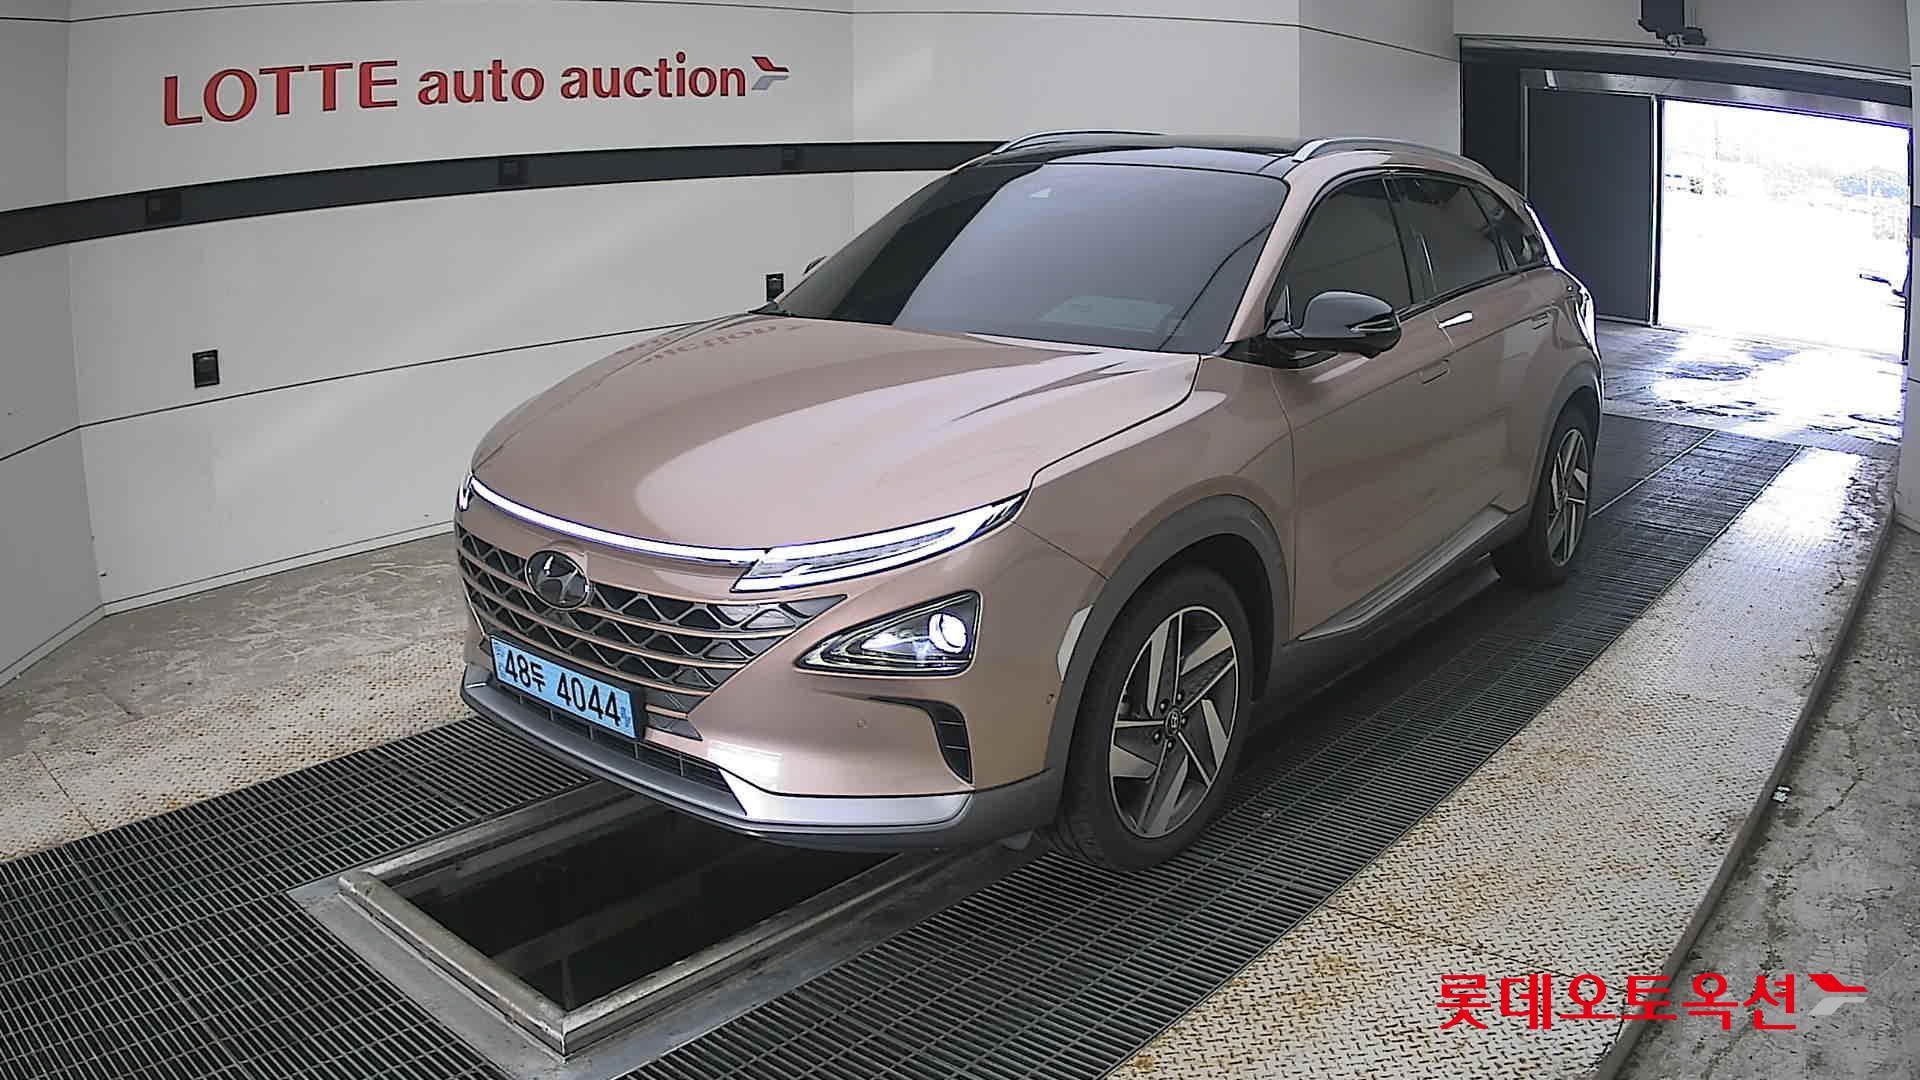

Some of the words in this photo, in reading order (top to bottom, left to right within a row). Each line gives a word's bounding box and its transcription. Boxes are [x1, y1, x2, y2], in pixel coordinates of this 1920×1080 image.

[163, 60, 399, 126] LOTTE
[417, 60, 545, 105] auto
[562, 52, 748, 98] auction
[505, 649, 546, 693] 48두
[557, 672, 621, 727] 4044
